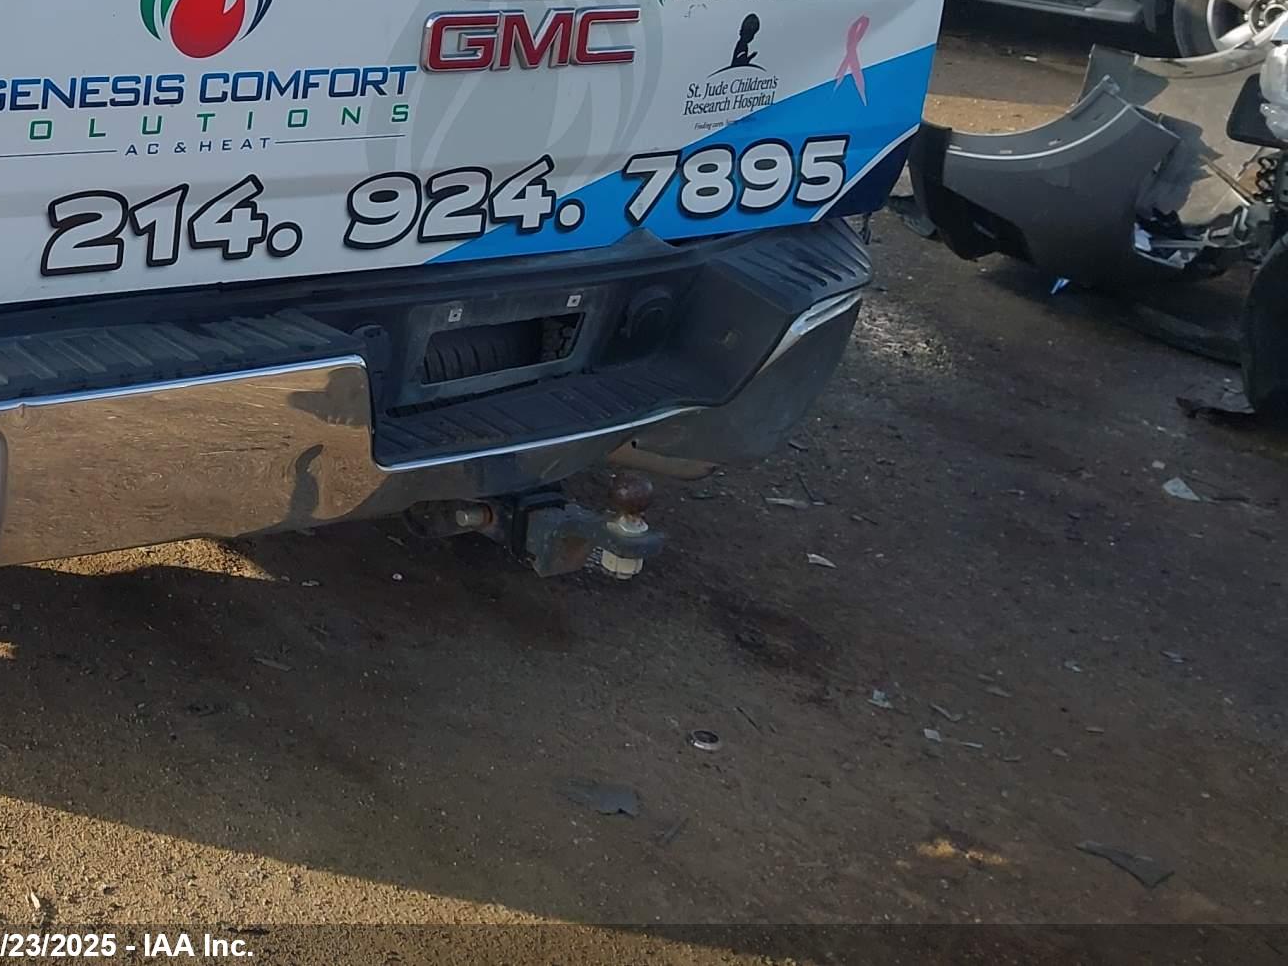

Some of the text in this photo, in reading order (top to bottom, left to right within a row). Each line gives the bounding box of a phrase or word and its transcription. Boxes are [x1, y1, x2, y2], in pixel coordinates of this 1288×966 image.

[422, 5, 641, 73] GMC
[198, 65, 418, 106] COMFORT
[687, 75, 779, 100] St. Jude Children's
[683, 96, 731, 115] Research
[125, 137, 271, 156] AC & HEAT
[41, 135, 851, 276] 214. 924. 7895
